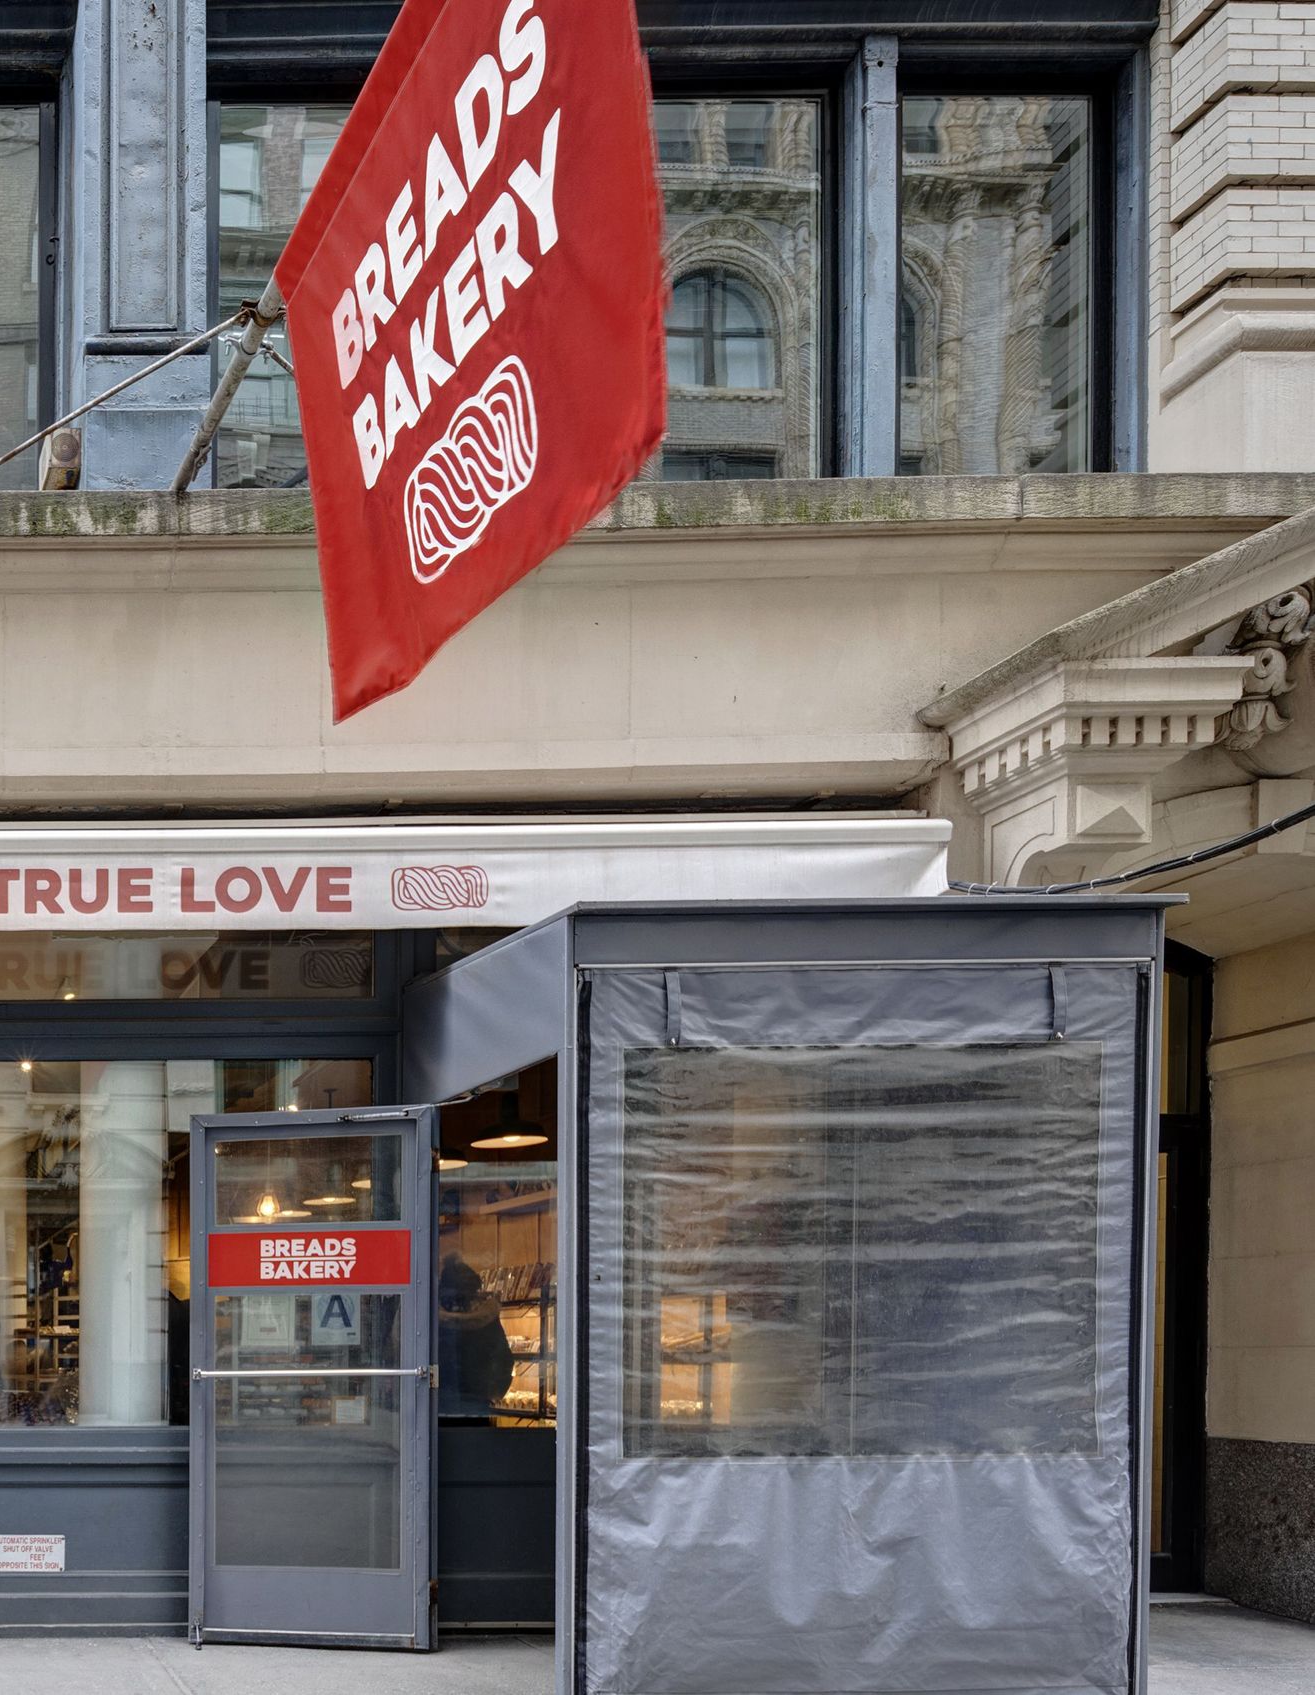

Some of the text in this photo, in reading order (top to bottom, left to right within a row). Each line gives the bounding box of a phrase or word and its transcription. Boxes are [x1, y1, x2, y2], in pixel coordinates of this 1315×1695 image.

[332, 0, 546, 390] BREADS
[353, 107, 561, 490] BAKERY
[180, 866, 352, 913] LOVE
[126, 950, 269, 991] LOVE
[260, 1238, 357, 1257] BREADS
[260, 1261, 356, 1280] BAKERY
[320, 1294, 352, 1328] A
[3, 1545, 54, 1553] SHUT OFF VALVE
[29, 1536, 62, 1545] SPRINKLER
[30, 1553, 46, 1561] FEET
